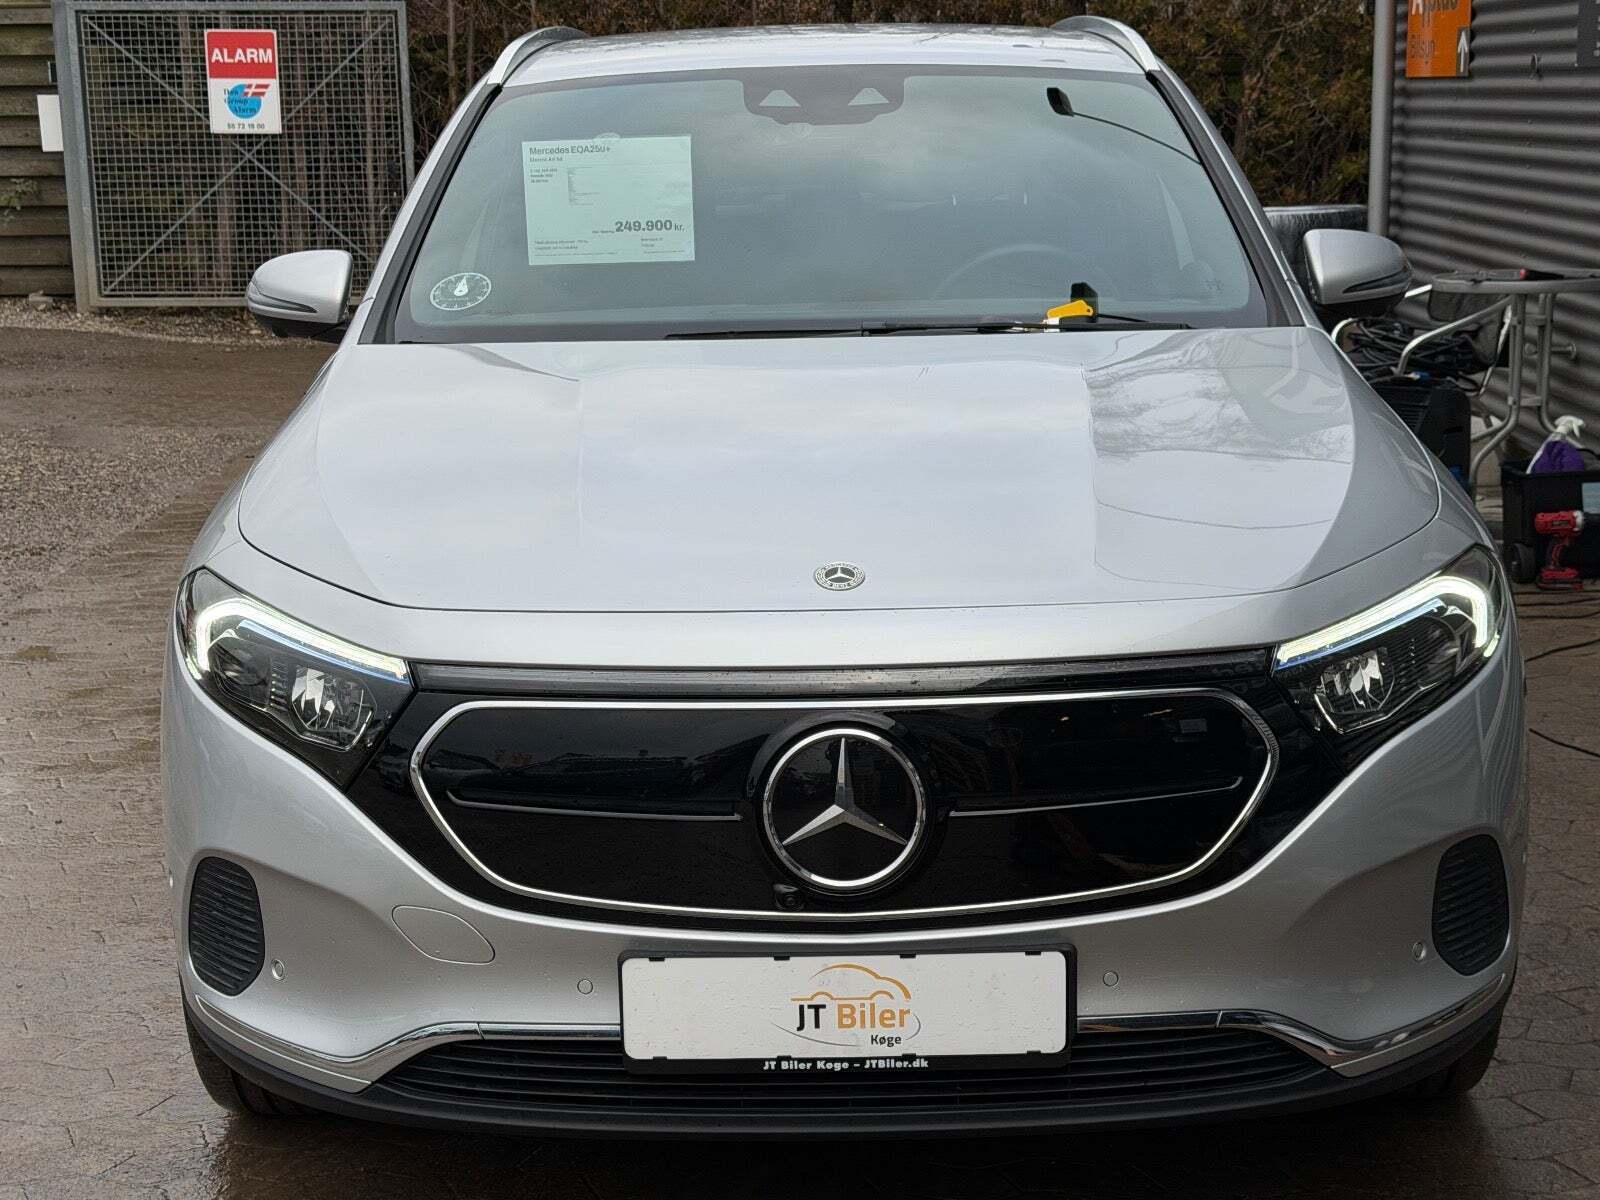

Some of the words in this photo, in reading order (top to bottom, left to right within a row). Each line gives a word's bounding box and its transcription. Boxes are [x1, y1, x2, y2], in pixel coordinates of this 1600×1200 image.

[211, 48, 272, 63] ALARM
[529, 146, 570, 155] Mercedes
[615, 220, 673, 232] 249.900
[674, 223, 685, 232] kr.
[797, 1004, 826, 1031] JT
[838, 1003, 911, 1029] Biler
[871, 1034, 902, 1047] Køge
[763, 1061, 777, 1070] JT
[781, 1060, 812, 1069] Biler
[864, 1059, 929, 1069] JTBiler.dk
